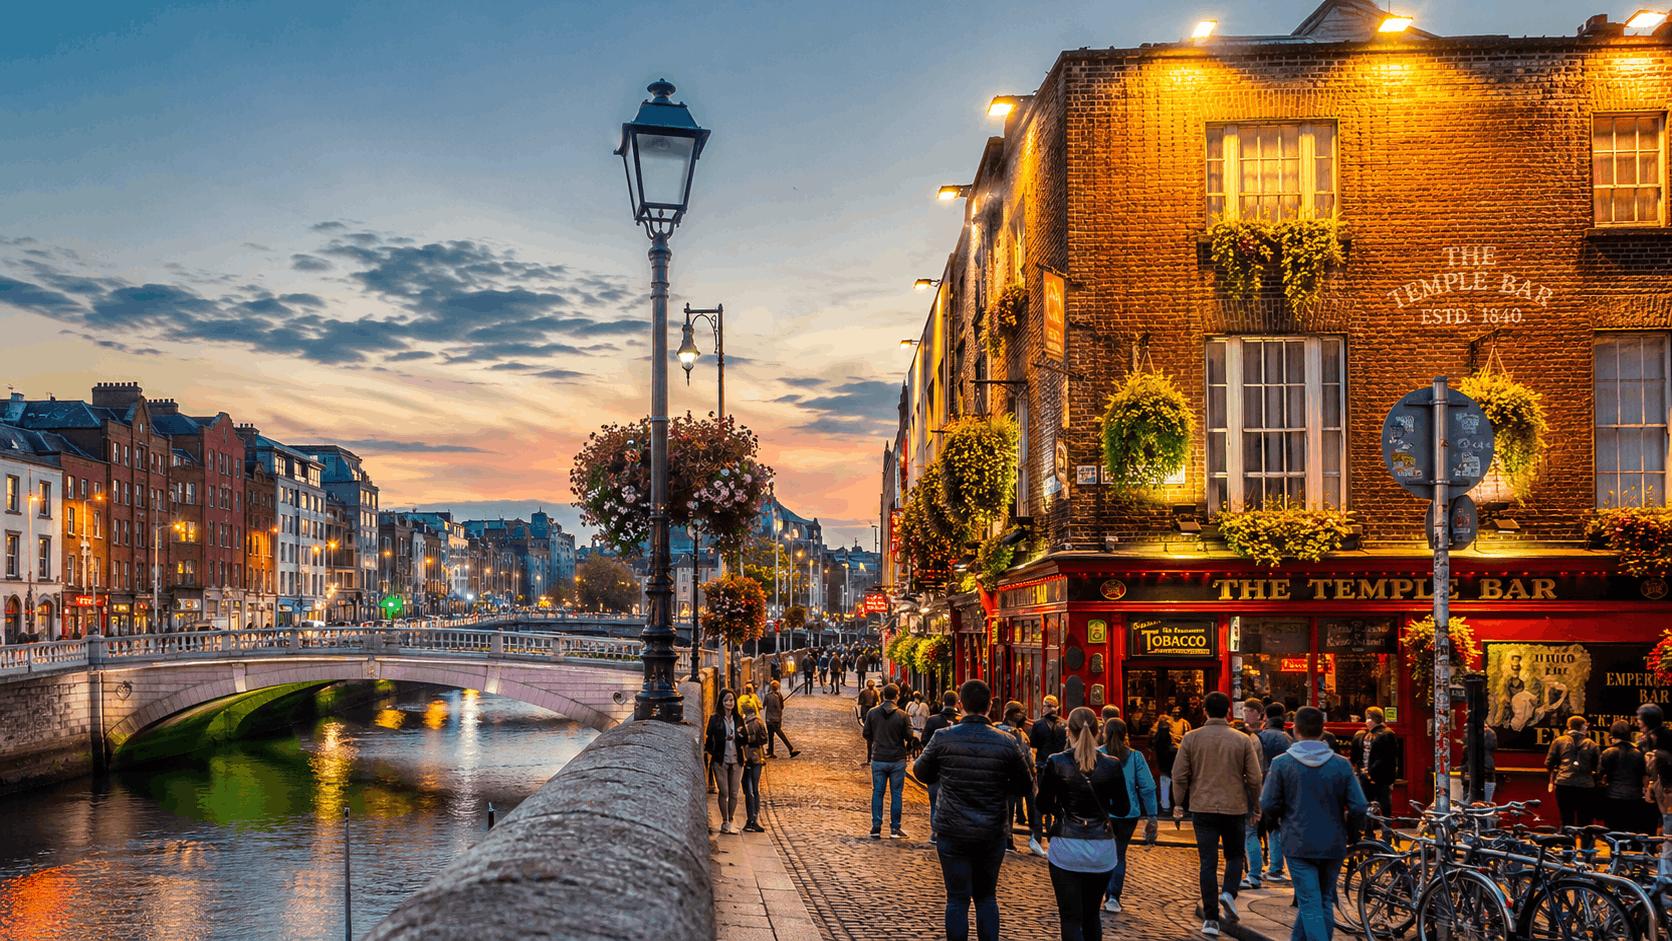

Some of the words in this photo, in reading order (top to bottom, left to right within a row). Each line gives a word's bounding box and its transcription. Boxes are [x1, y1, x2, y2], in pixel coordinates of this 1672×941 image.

[1442, 246, 1497, 266] THE
[1386, 271, 1489, 309] TEMPLE
[1498, 273, 1553, 307] BAR
[1421, 308, 1471, 325] ESTD.
[1482, 307, 1527, 324] 1840.
[1212, 578, 1291, 600] THE
[1478, 578, 1558, 600] BAR
[1605, 672, 1671, 687] EMPER
[1639, 689, 1670, 704] BAR
